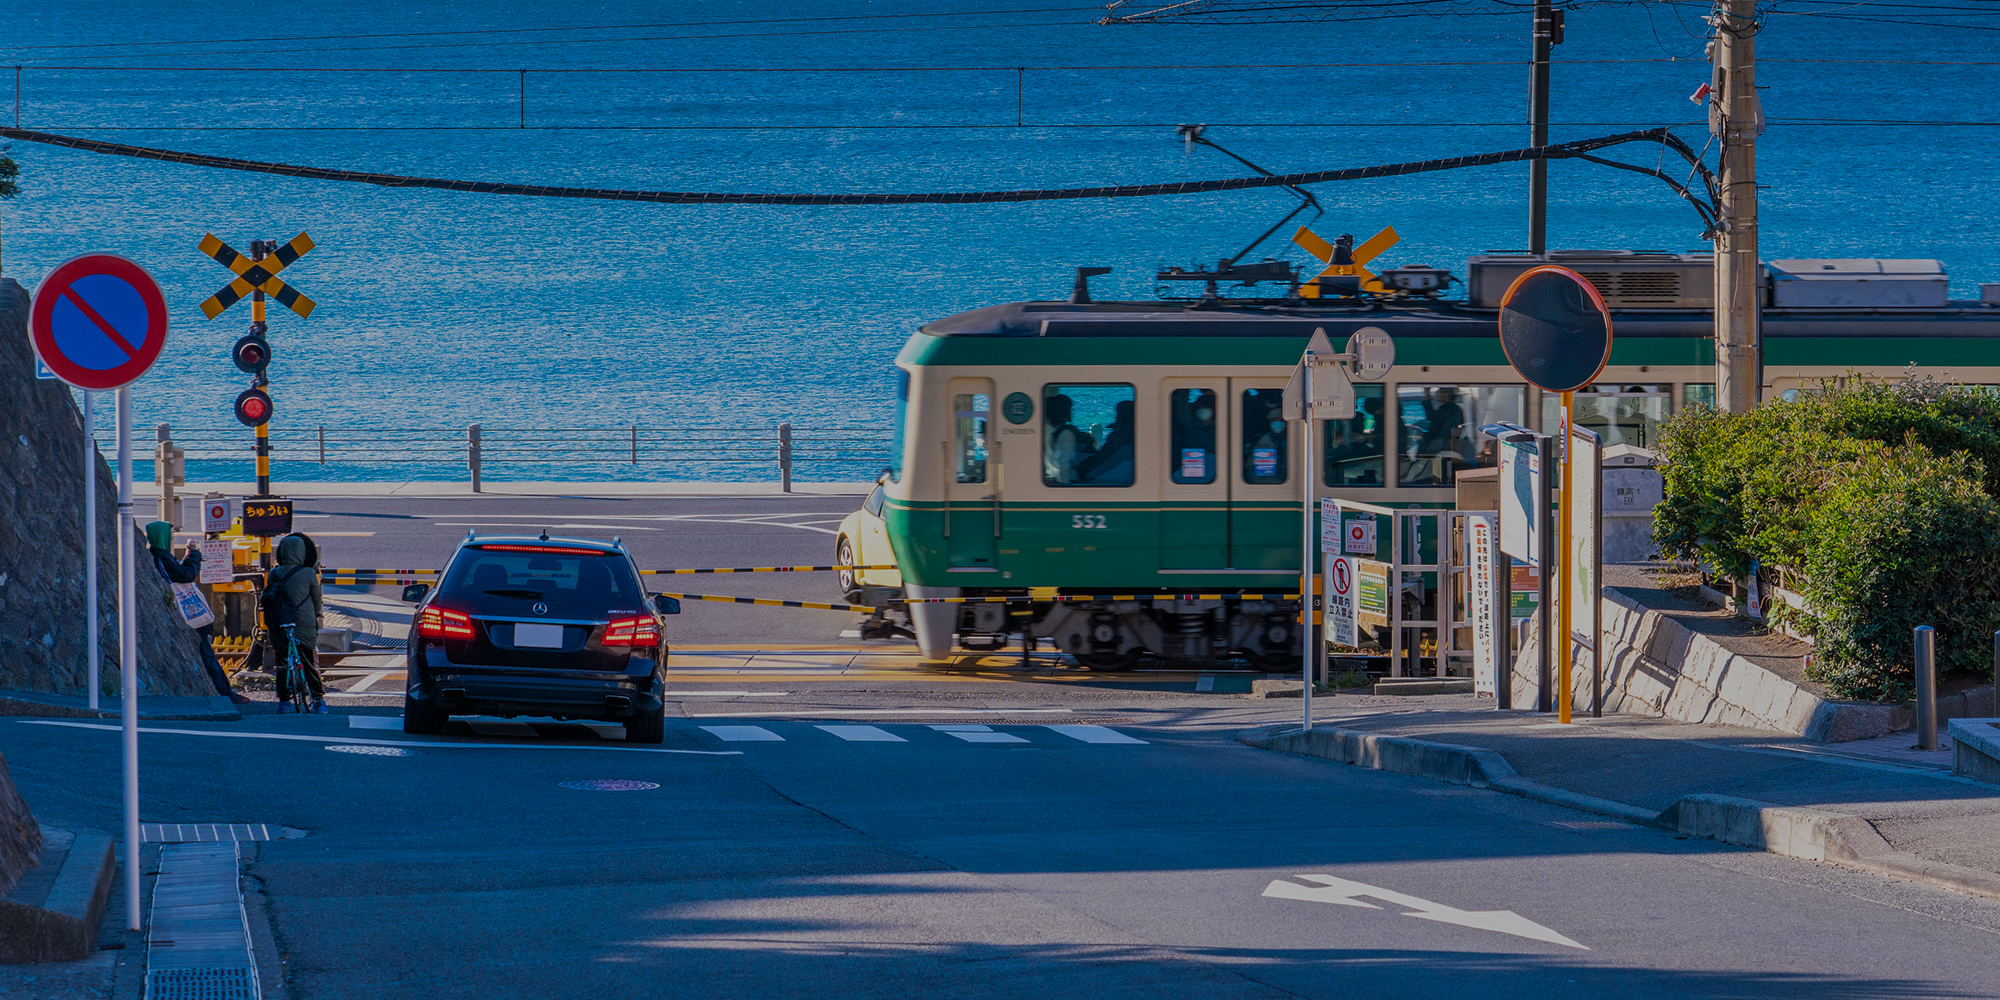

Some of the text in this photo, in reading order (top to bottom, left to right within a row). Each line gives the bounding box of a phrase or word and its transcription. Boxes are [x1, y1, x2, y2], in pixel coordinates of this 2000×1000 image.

[245, 504, 289, 517] ちゅうい
[1071, 514, 1108, 529] 552
[1329, 604, 1354, 619] 立入禁止
